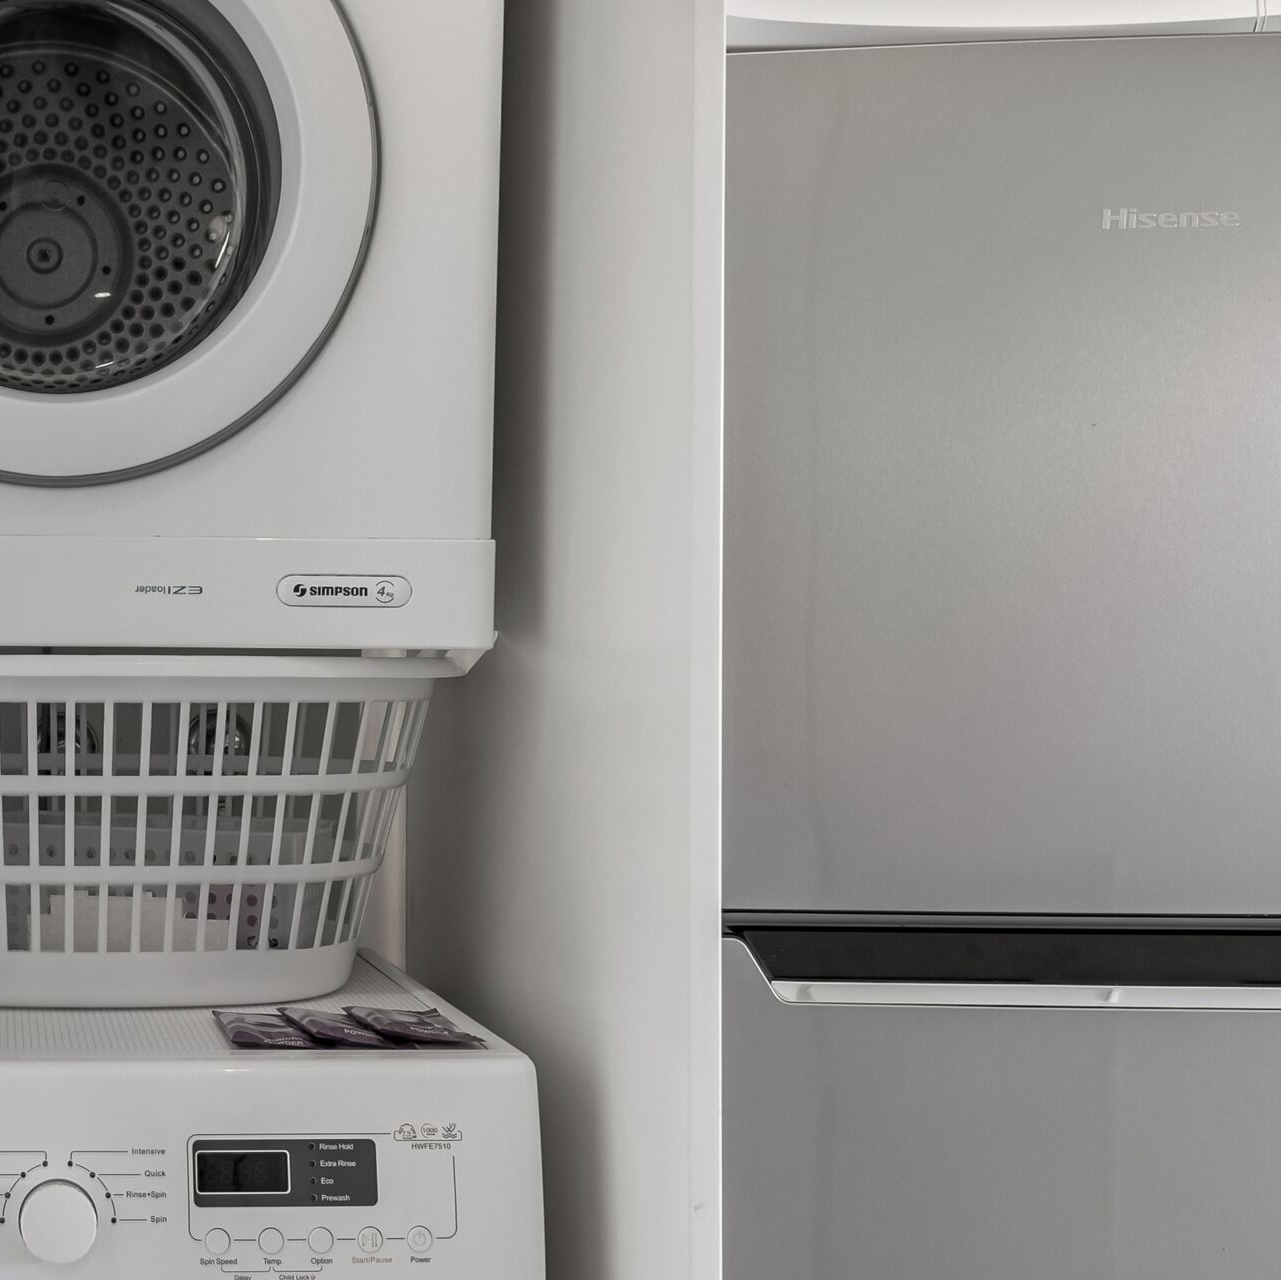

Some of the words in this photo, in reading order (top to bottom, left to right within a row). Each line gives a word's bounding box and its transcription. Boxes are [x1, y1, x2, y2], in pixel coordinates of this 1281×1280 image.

[1101, 207, 1241, 230] Hisense
[377, 586, 386, 596] 4
[126, 1191, 167, 1199] Rinse+Spin
[150, 1216, 167, 1224] Spin
[199, 1258, 215, 1266] Spin
[216, 1258, 238, 1266] Speed
[311, 1257, 333, 1265] Option
